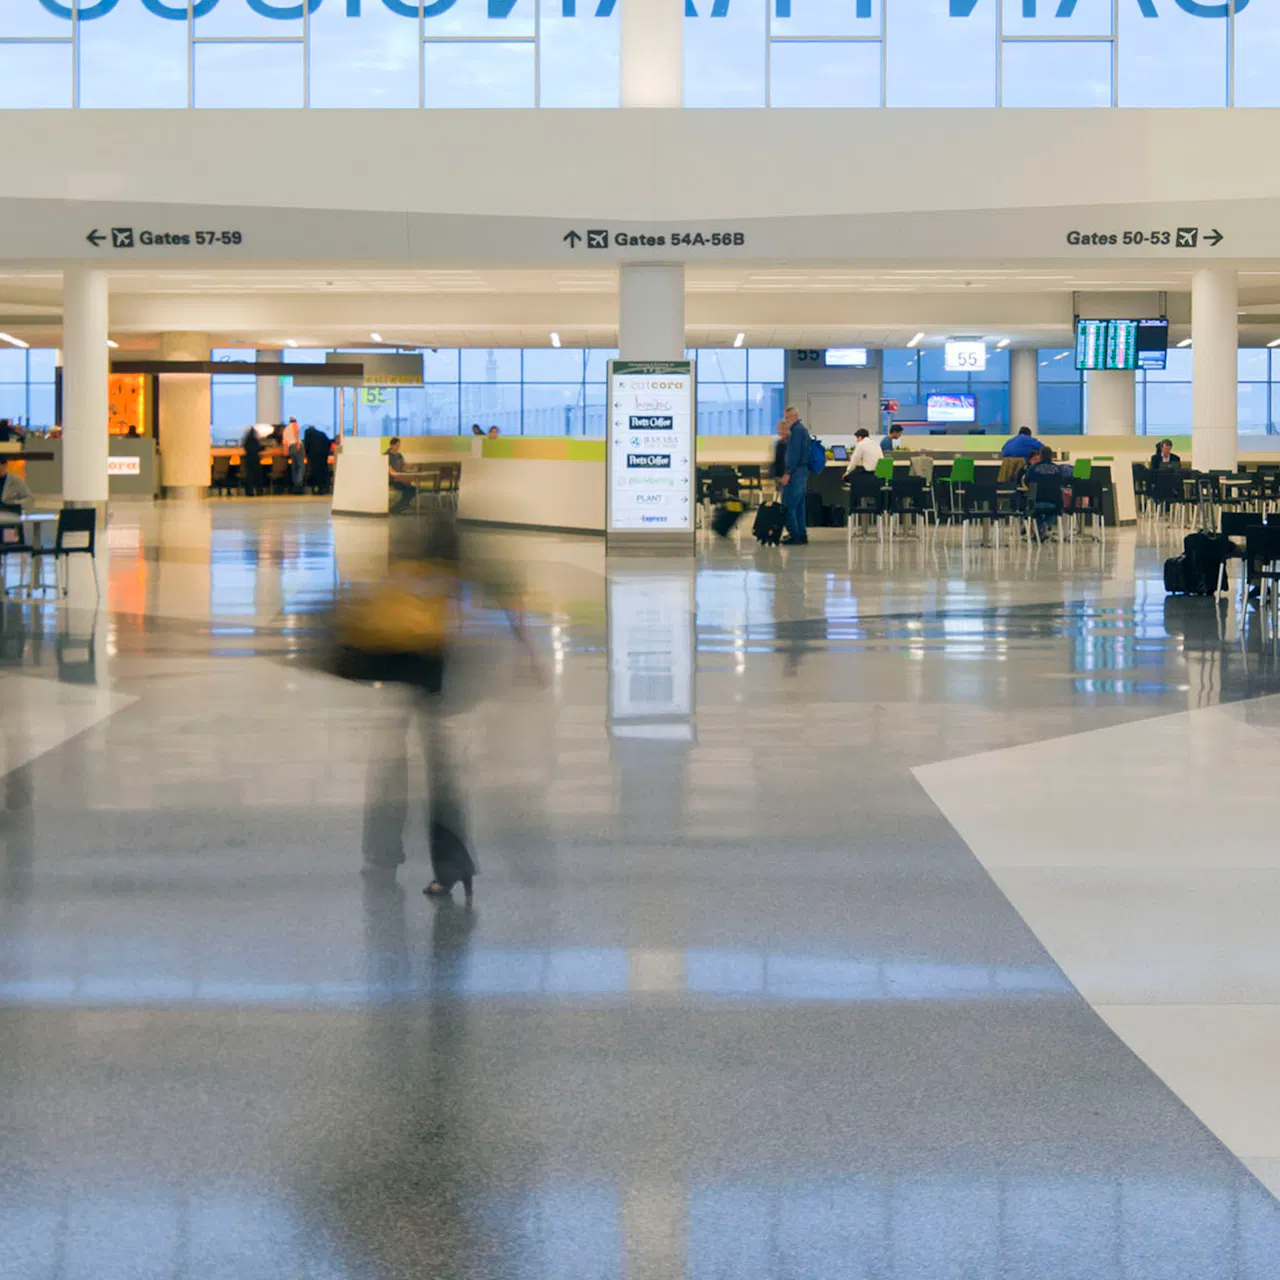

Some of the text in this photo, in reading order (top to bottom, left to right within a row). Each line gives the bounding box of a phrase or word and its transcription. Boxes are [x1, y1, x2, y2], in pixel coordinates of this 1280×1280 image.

[139, 230, 242, 245] Gates 57-59
[614, 232, 745, 246] Gates 54A-56B
[1066, 230, 1171, 245] Gates 50-53
[797, 349, 820, 361] 55
[957, 351, 977, 367] 55
